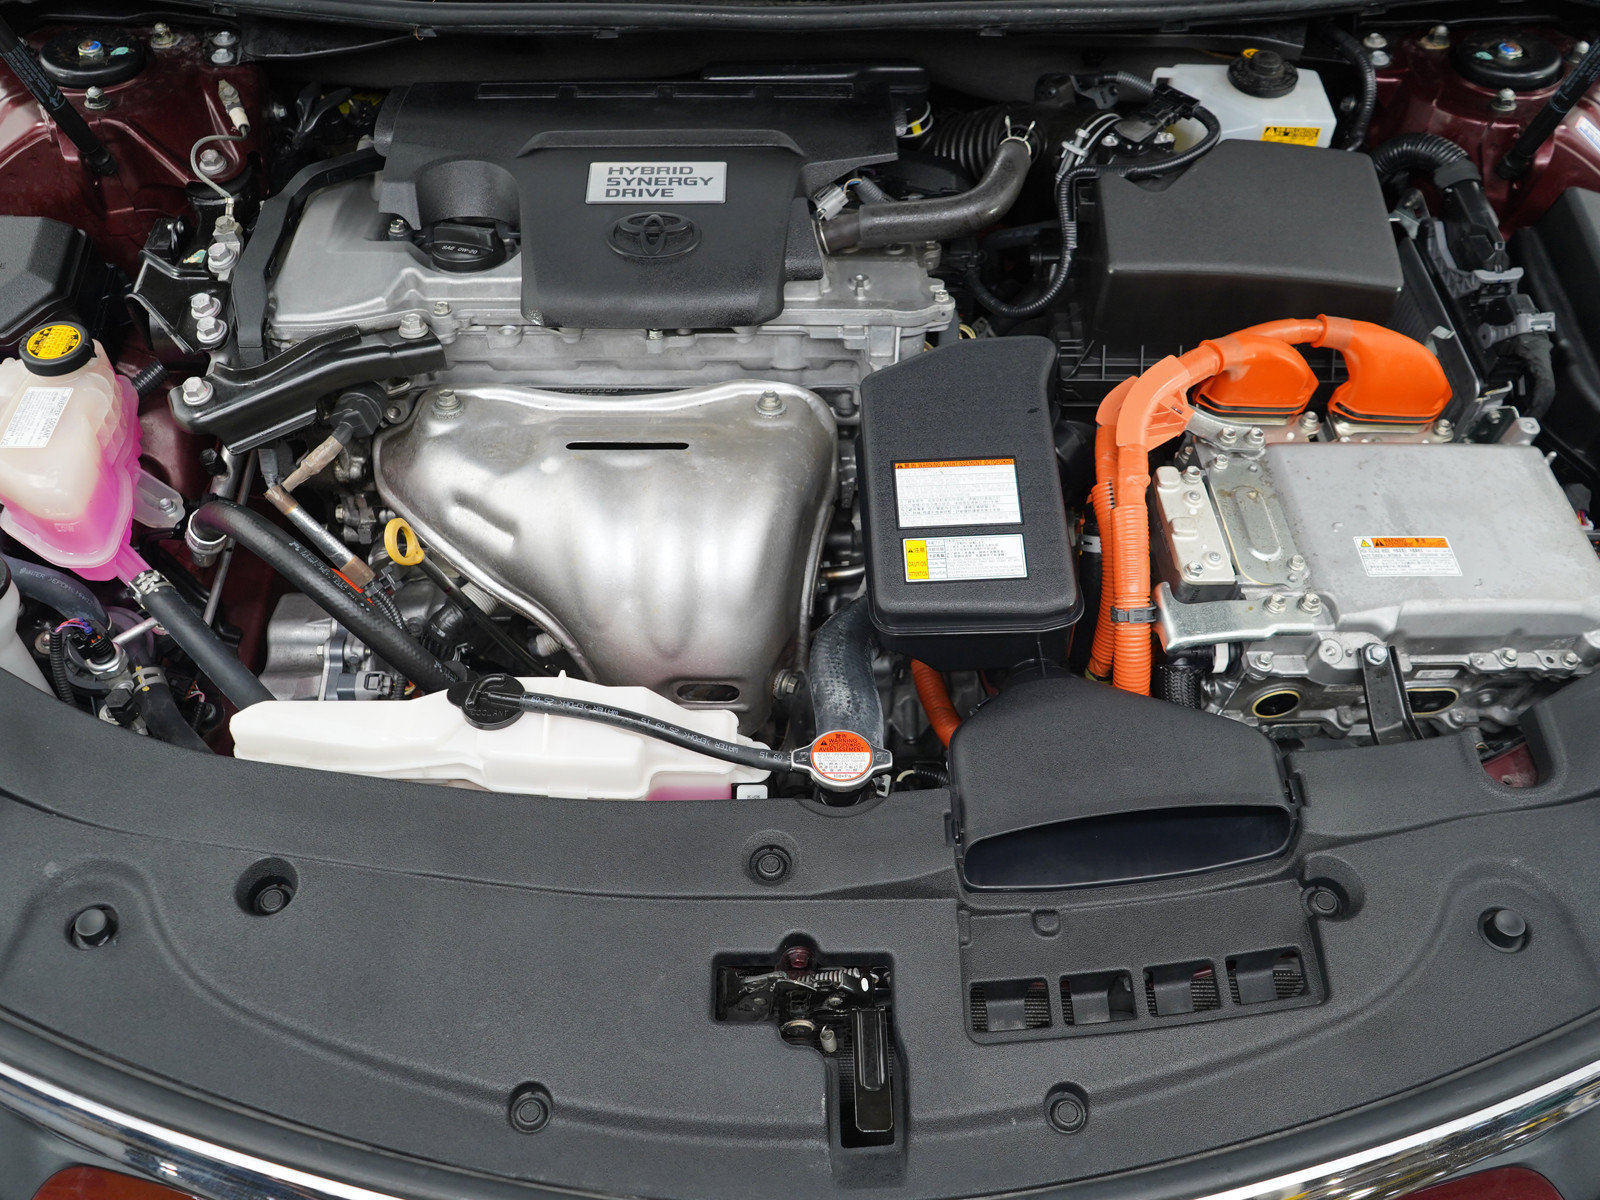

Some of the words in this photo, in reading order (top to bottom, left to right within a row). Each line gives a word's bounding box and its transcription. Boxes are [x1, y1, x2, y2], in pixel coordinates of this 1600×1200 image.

[608, 166, 694, 175] HYBRID
[606, 177, 714, 186] SYNERGY
[605, 188, 674, 198] DRIVE
[457, 247, 478, 255] 0W-20
[470, 709, 509, 717] COOLANT
[594, 705, 619, 716] WATER
[640, 717, 651, 726] 15
[655, 721, 666, 731] 09
[669, 726, 680, 735] 25
[714, 741, 739, 754] WATER
[759, 751, 769, 760] 15
[773, 754, 783, 762] 09
